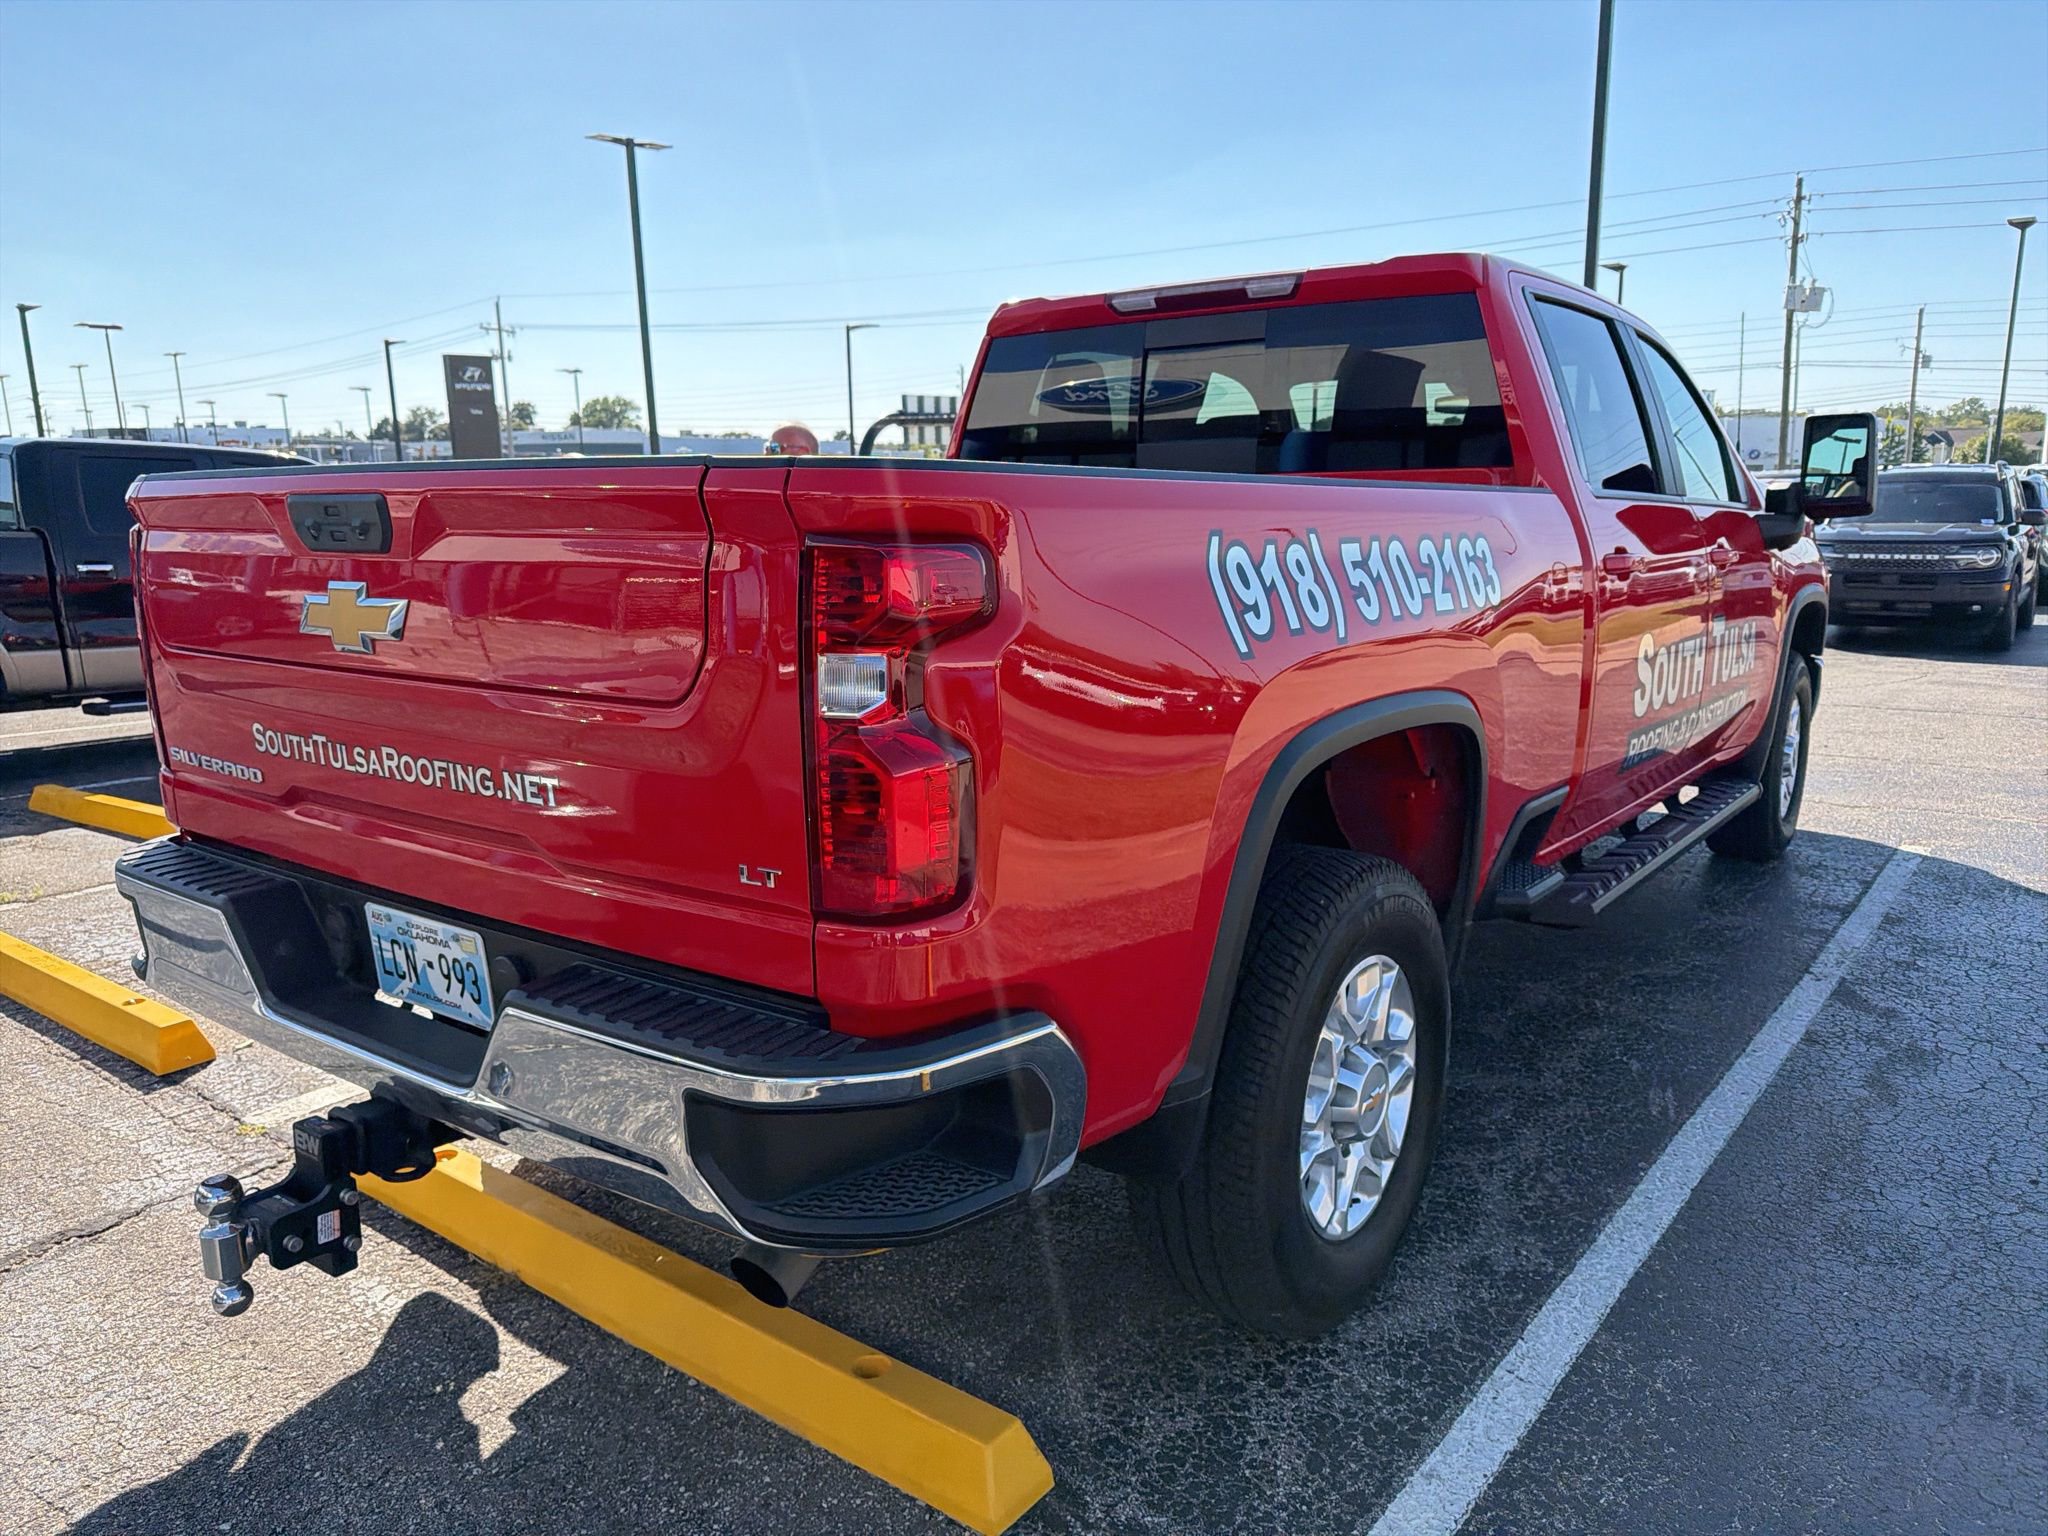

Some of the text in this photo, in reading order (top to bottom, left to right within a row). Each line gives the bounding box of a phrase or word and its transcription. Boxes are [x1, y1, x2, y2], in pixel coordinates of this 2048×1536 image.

[541, 431, 576, 441] NISSAN
[1206, 529, 1502, 657] (918) 510-2163
[169, 746, 264, 783] SILVERADO
[738, 864, 782, 888] LT
[396, 926, 451, 950] OKLAHOMA
[405, 920, 440, 936] EXPLORE
